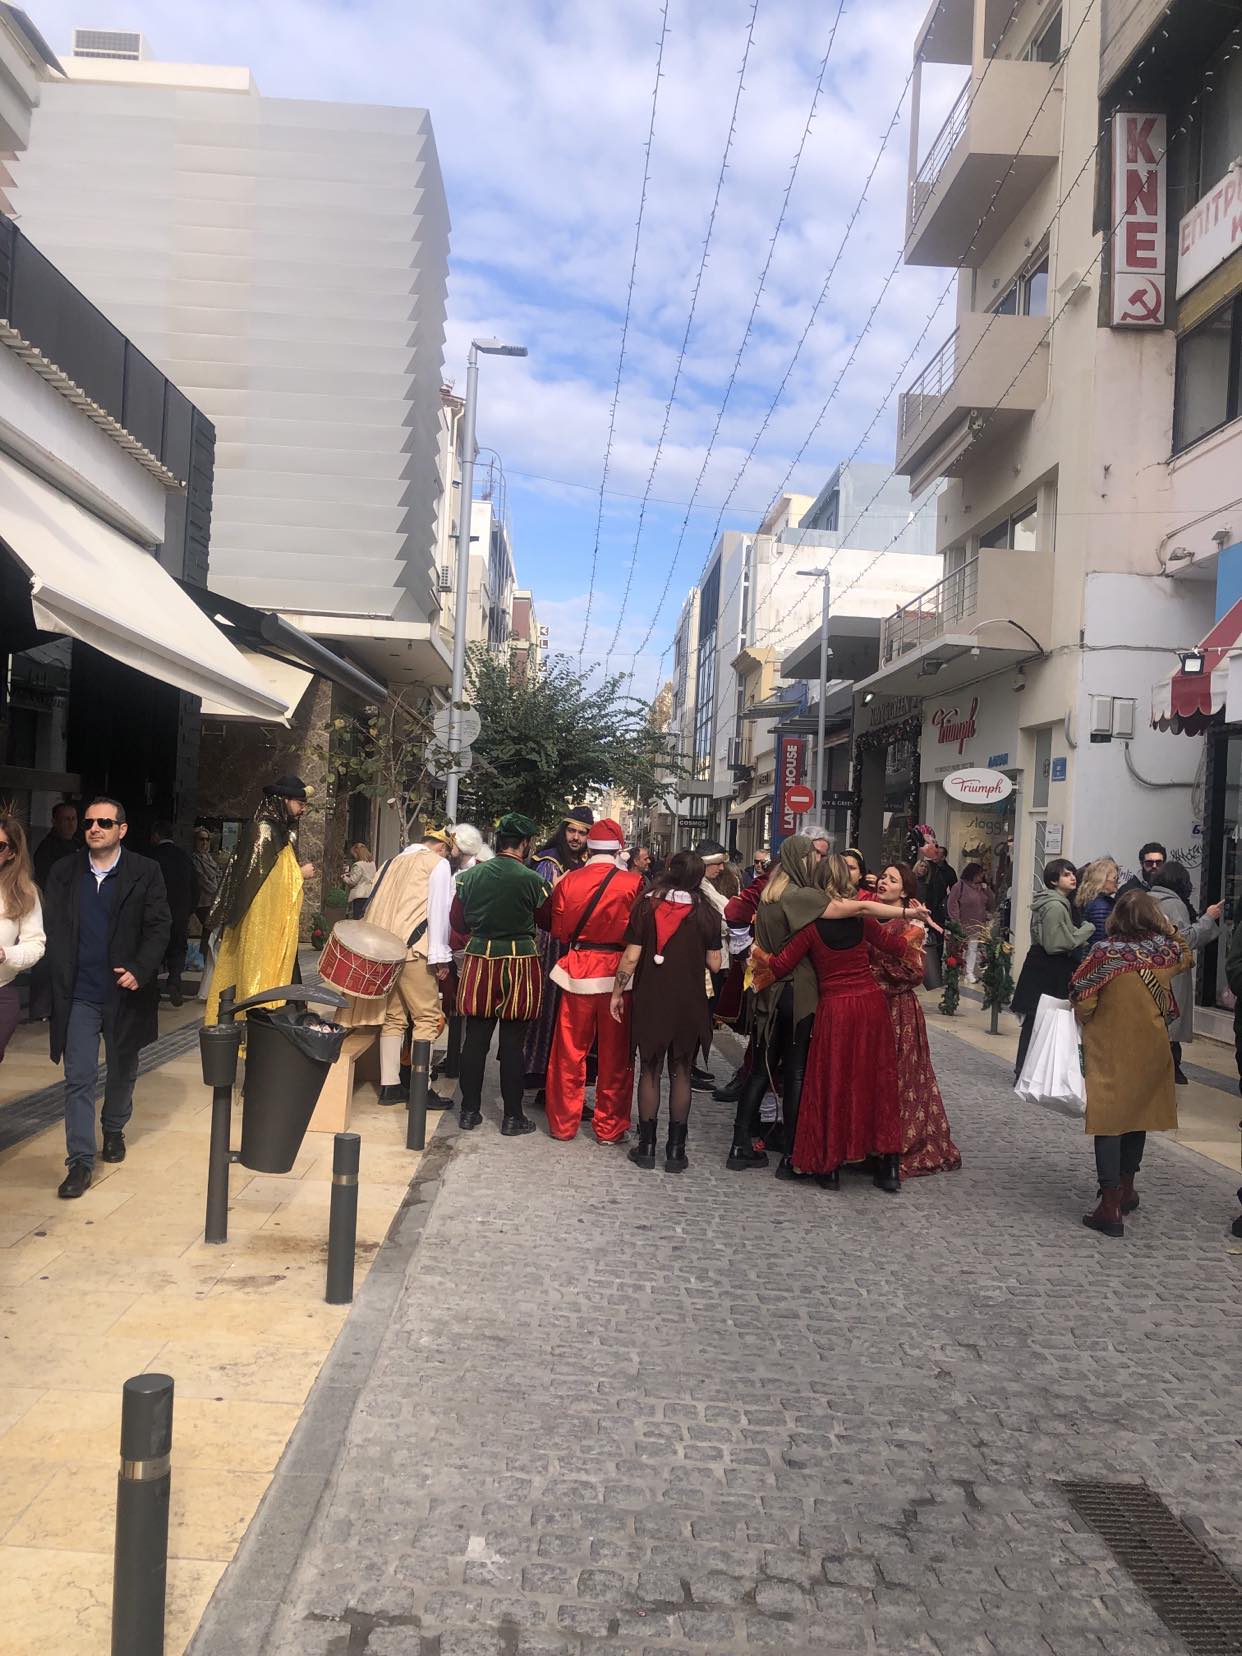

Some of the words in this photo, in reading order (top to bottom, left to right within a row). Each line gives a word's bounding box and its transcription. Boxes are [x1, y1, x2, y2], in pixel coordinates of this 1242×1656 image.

[1126, 117, 1158, 268] ΚΝΕ
[1181, 166, 1242, 256] ΕΠΙΤΡ
[932, 696, 978, 755] Triumph
[785, 745, 798, 787] HOUSE
[951, 778, 1003, 799] Triumph
